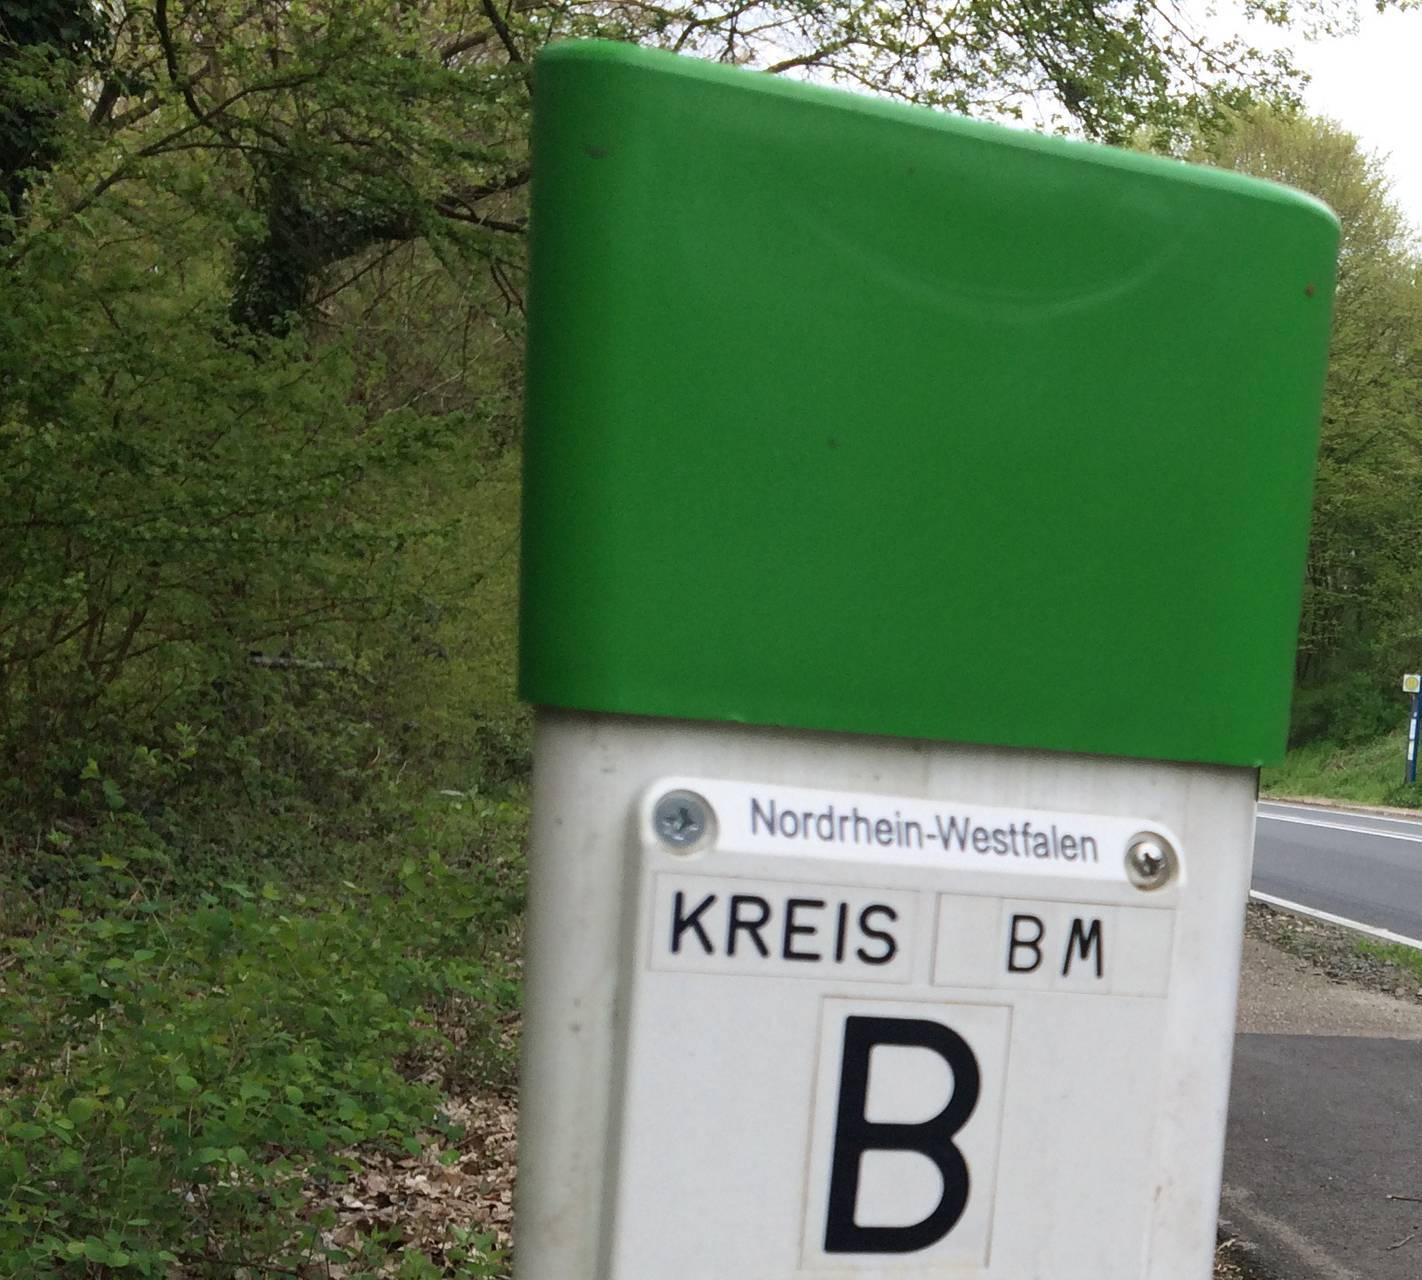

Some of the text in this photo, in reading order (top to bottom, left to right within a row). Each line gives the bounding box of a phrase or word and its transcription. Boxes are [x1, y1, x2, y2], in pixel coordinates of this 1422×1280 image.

[749, 798, 1099, 863] Nordrhein-Westfalen
[670, 890, 898, 965] KREIS
[823, 1014, 981, 1254] B
